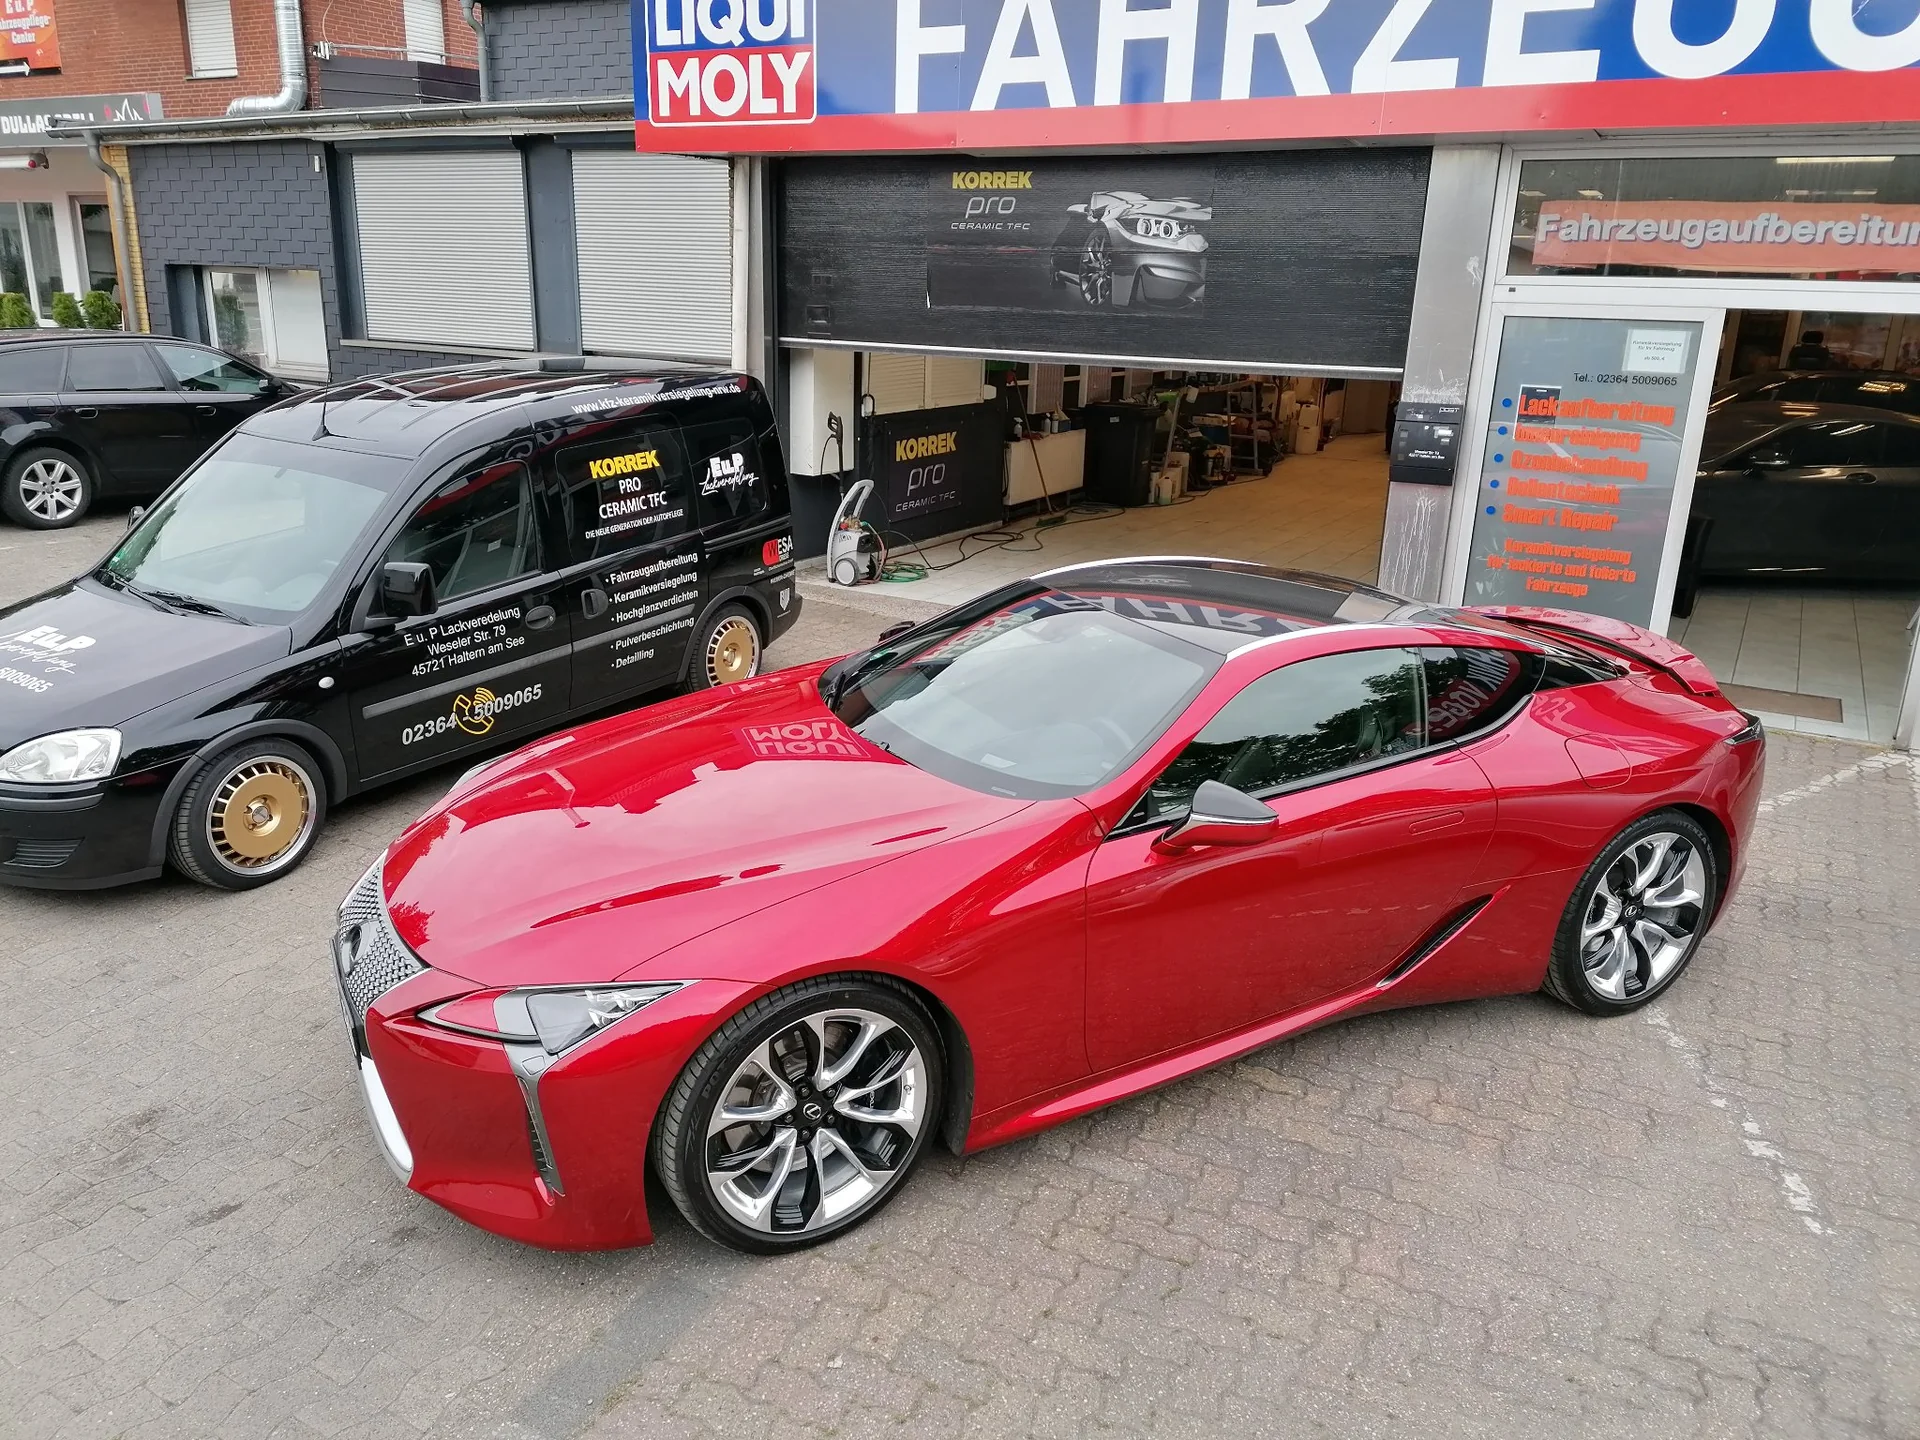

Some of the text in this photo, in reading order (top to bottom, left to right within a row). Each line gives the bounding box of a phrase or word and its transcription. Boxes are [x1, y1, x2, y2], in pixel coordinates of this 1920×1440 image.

[655, 0, 804, 46] LIQUI
[656, 52, 811, 117] MOLY
[952, 171, 1033, 189] KORREK
[965, 196, 1016, 218] pro
[951, 222, 1031, 230] CERAMIC TFC
[1574, 373, 1678, 386] Tel.: 02364 5009065
[571, 383, 742, 414] www.kfz-keramikversiegelung-nrw.de
[1518, 394, 1676, 427] Lackaufbereitung
[895, 431, 957, 462] KORREK
[589, 451, 660, 479] KORREK
[907, 463, 946, 497] pro
[618, 477, 642, 494] PRO
[599, 491, 668, 519] CERAMIC TFC
[895, 491, 956, 512] CERAMIC TFC
[585, 508, 684, 539] DIE NEUE GENERATION DER AUTOPFLEGE
[1502, 504, 1619, 532] Smart Repair
[609, 552, 698, 585] Fahrzeugaufbereitung
[613, 571, 698, 604] Keramikversiegelung
[616, 589, 699, 623] Hochglanzverdichten
[403, 633, 414, 647] E
[429, 627, 438, 640] P
[440, 606, 521, 636] Lackveredelung
[427, 624, 506, 656] Weseler Str. 79
[615, 617, 695, 650] Pulverbeschichtung
[411, 635, 525, 677] 45721 Haltern am See
[615, 647, 654, 669] Detailling
[402, 712, 457, 745] 02364
[474, 683, 542, 720] 5009065
